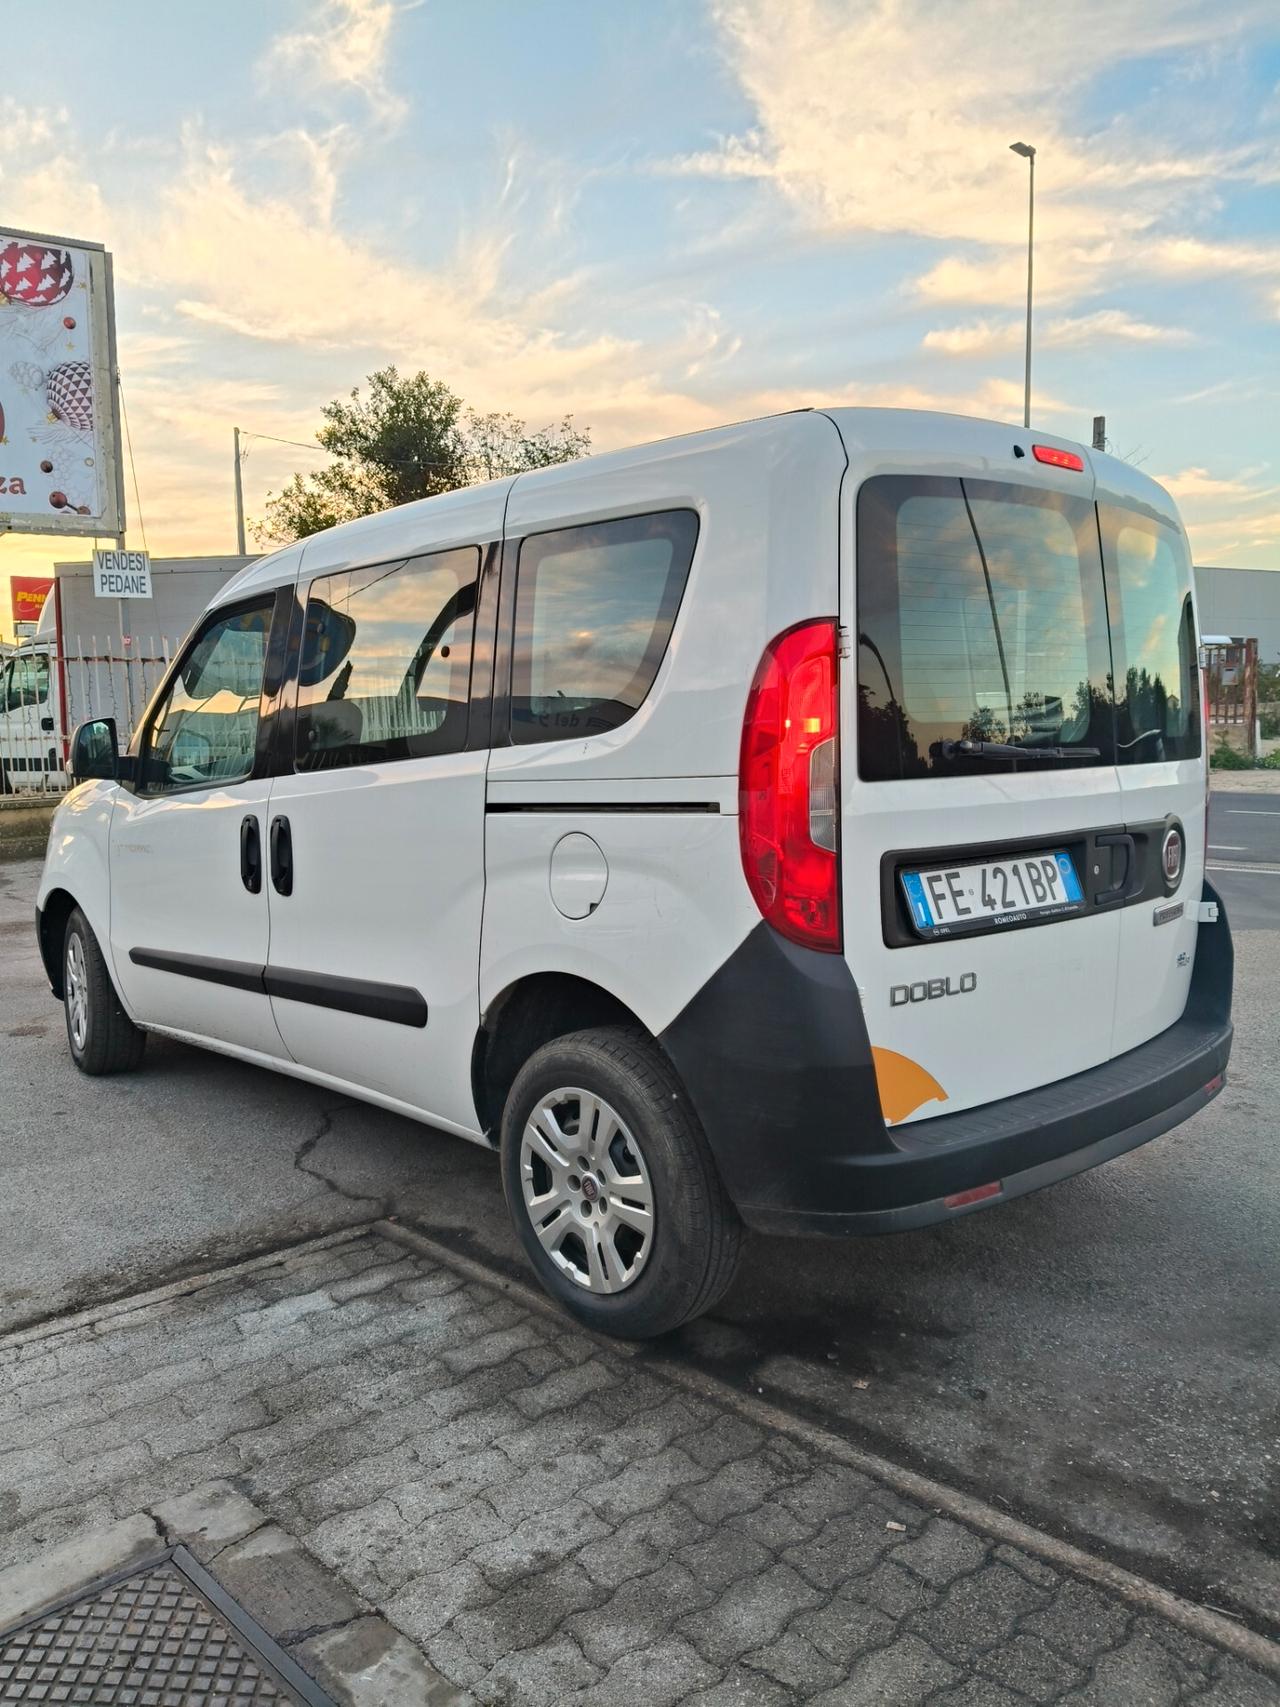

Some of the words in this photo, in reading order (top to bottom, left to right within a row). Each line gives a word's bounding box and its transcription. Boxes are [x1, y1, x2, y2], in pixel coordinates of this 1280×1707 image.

[97, 551, 146, 572] VENDESI
[100, 574, 147, 594] PEDANE
[926, 871, 972, 920] FE
[980, 860, 1059, 911] 421BP
[993, 913, 1027, 925] ROMEOAUTO
[889, 971, 978, 1008] DOBLO
